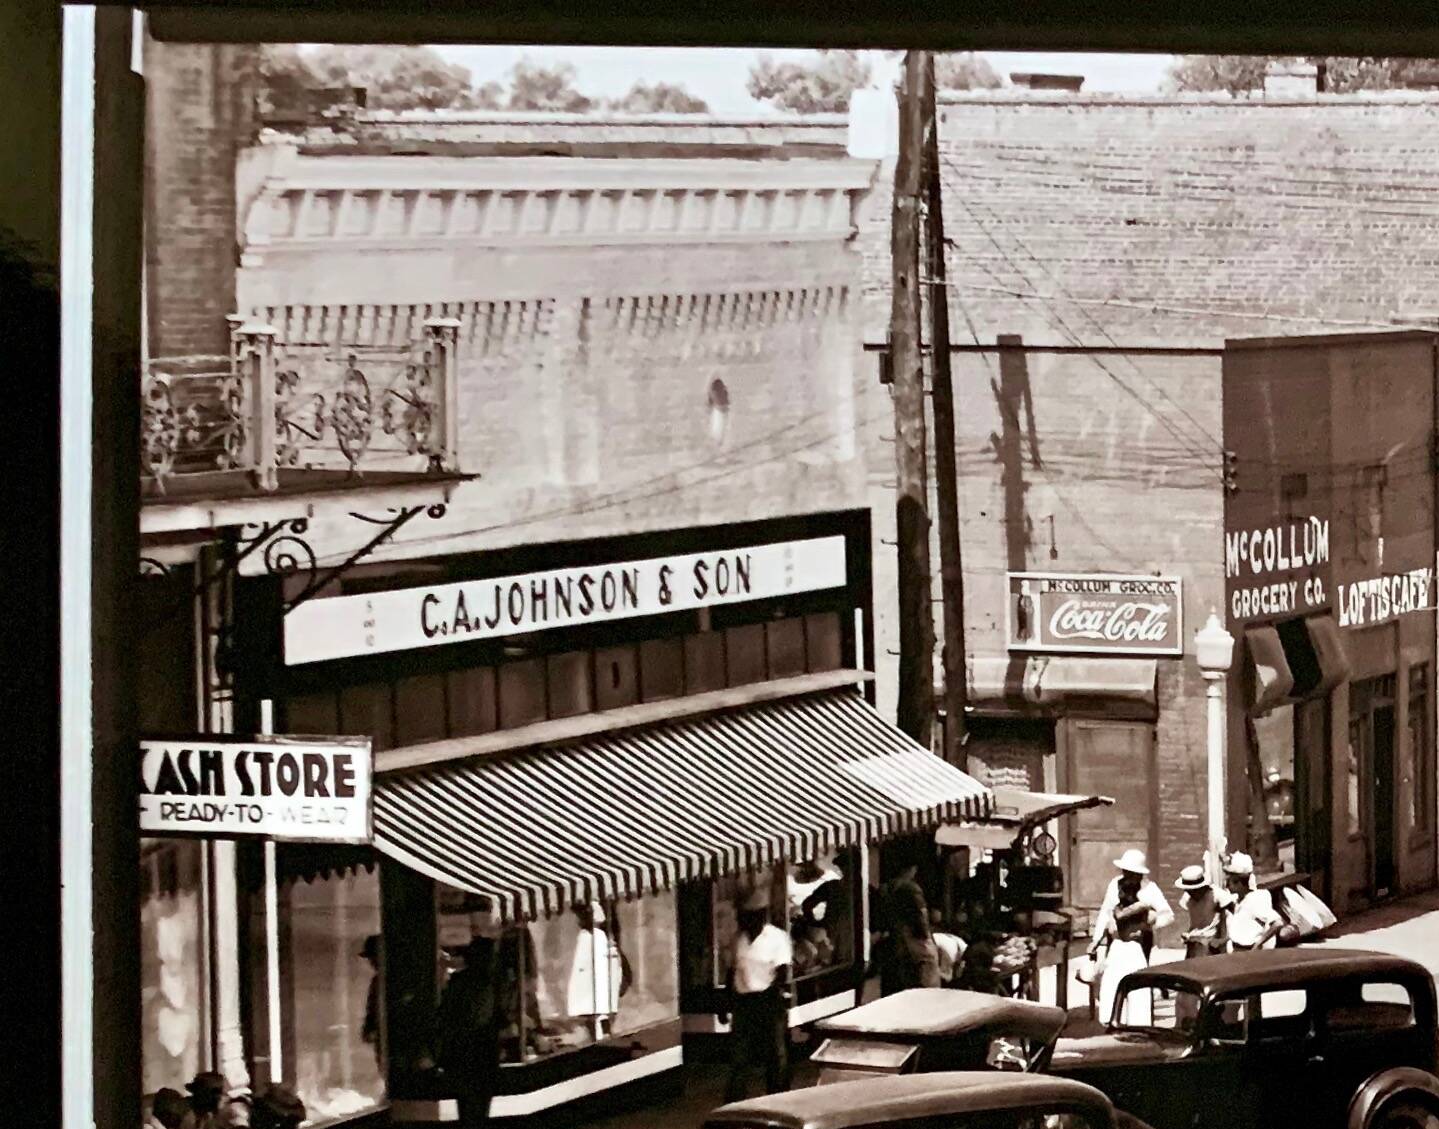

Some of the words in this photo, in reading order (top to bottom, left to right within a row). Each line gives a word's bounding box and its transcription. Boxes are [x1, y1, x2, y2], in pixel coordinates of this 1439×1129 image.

[657, 564, 674, 606] &
[693, 554, 752, 601] SON
[1231, 580, 1298, 620] GROCERY
[1303, 576, 1327, 607] CO.
[1337, 577, 1391, 628] LOFTIS
[1049, 599, 1171, 642] Coca-Cola
[234, 750, 356, 798] STORE
